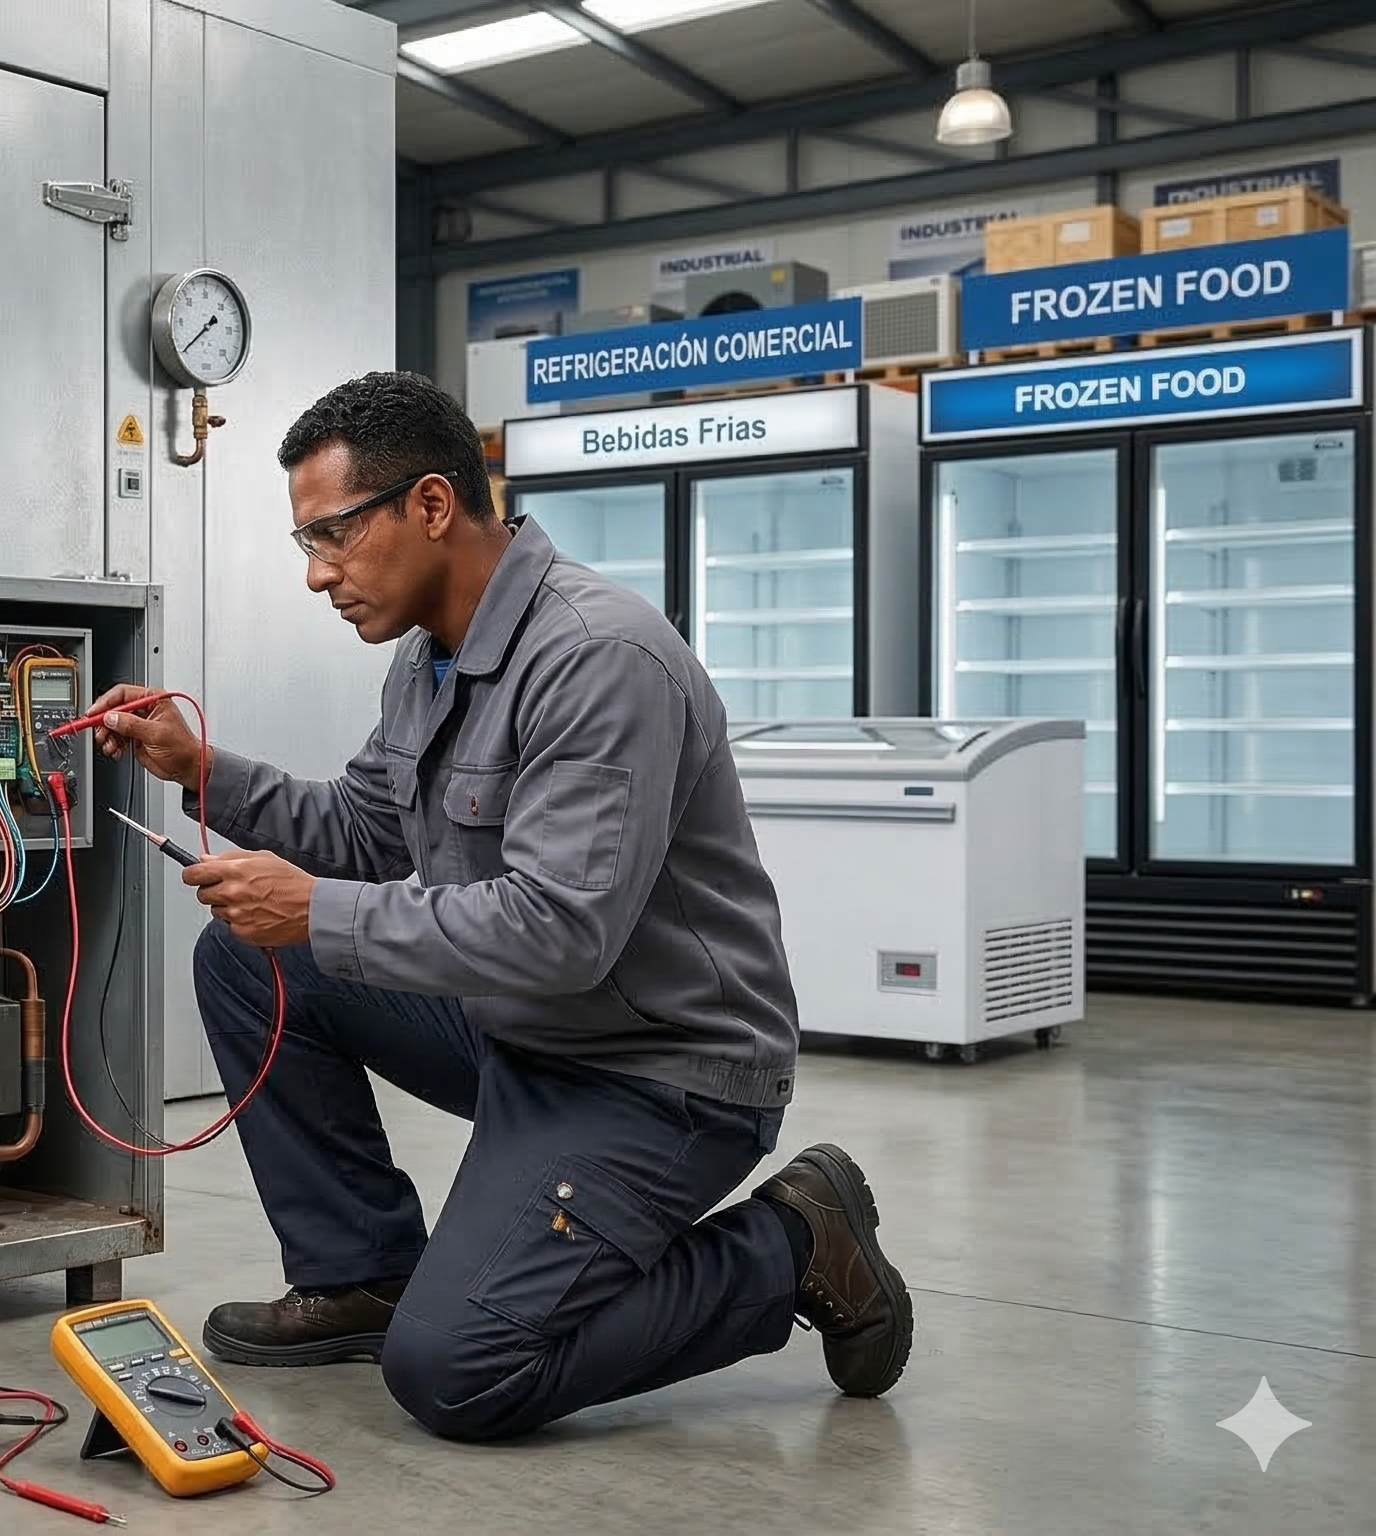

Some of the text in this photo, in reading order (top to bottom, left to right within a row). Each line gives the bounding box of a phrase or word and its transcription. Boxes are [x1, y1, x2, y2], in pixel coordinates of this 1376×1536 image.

[1011, 260, 1290, 324] FROZEN FOOD
[533, 320, 853, 385] REFRIGERACIÓN COMERCIAL
[1015, 366, 1246, 412] FROZEN FOOD
[582, 416, 766, 455] Bebidas Frias
